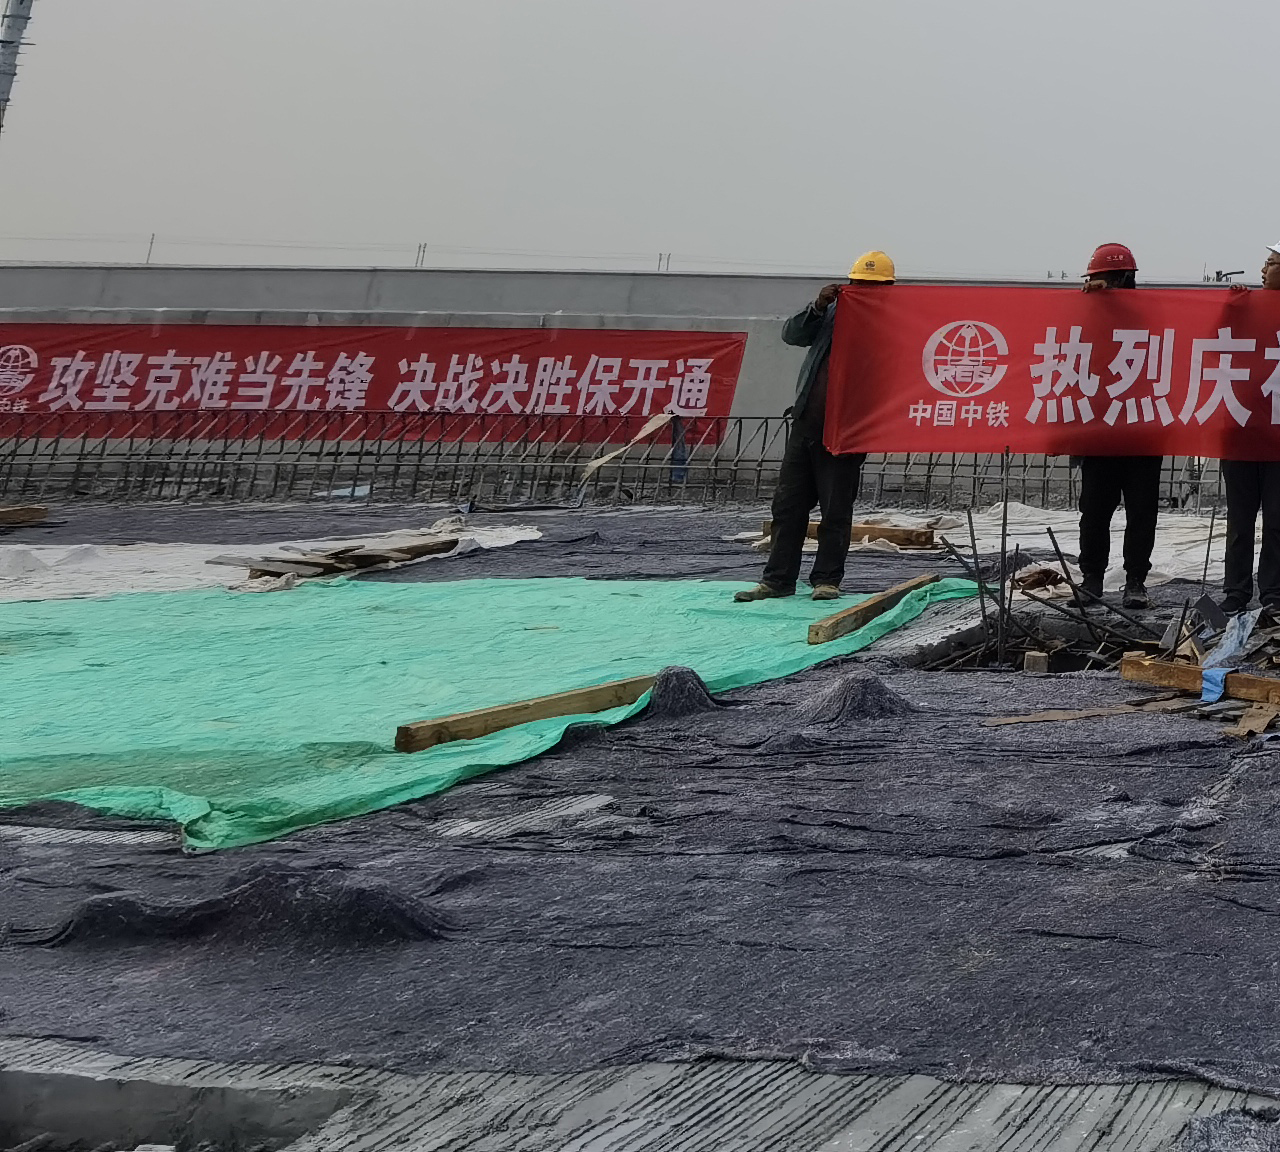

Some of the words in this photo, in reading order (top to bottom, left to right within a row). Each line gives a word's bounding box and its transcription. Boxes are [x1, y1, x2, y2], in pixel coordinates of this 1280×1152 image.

[38, 349, 375, 412] 攻坚克难当先锋
[387, 353, 714, 418] 决战决胜保开通
[908, 399, 1010, 428] 中国中铁
